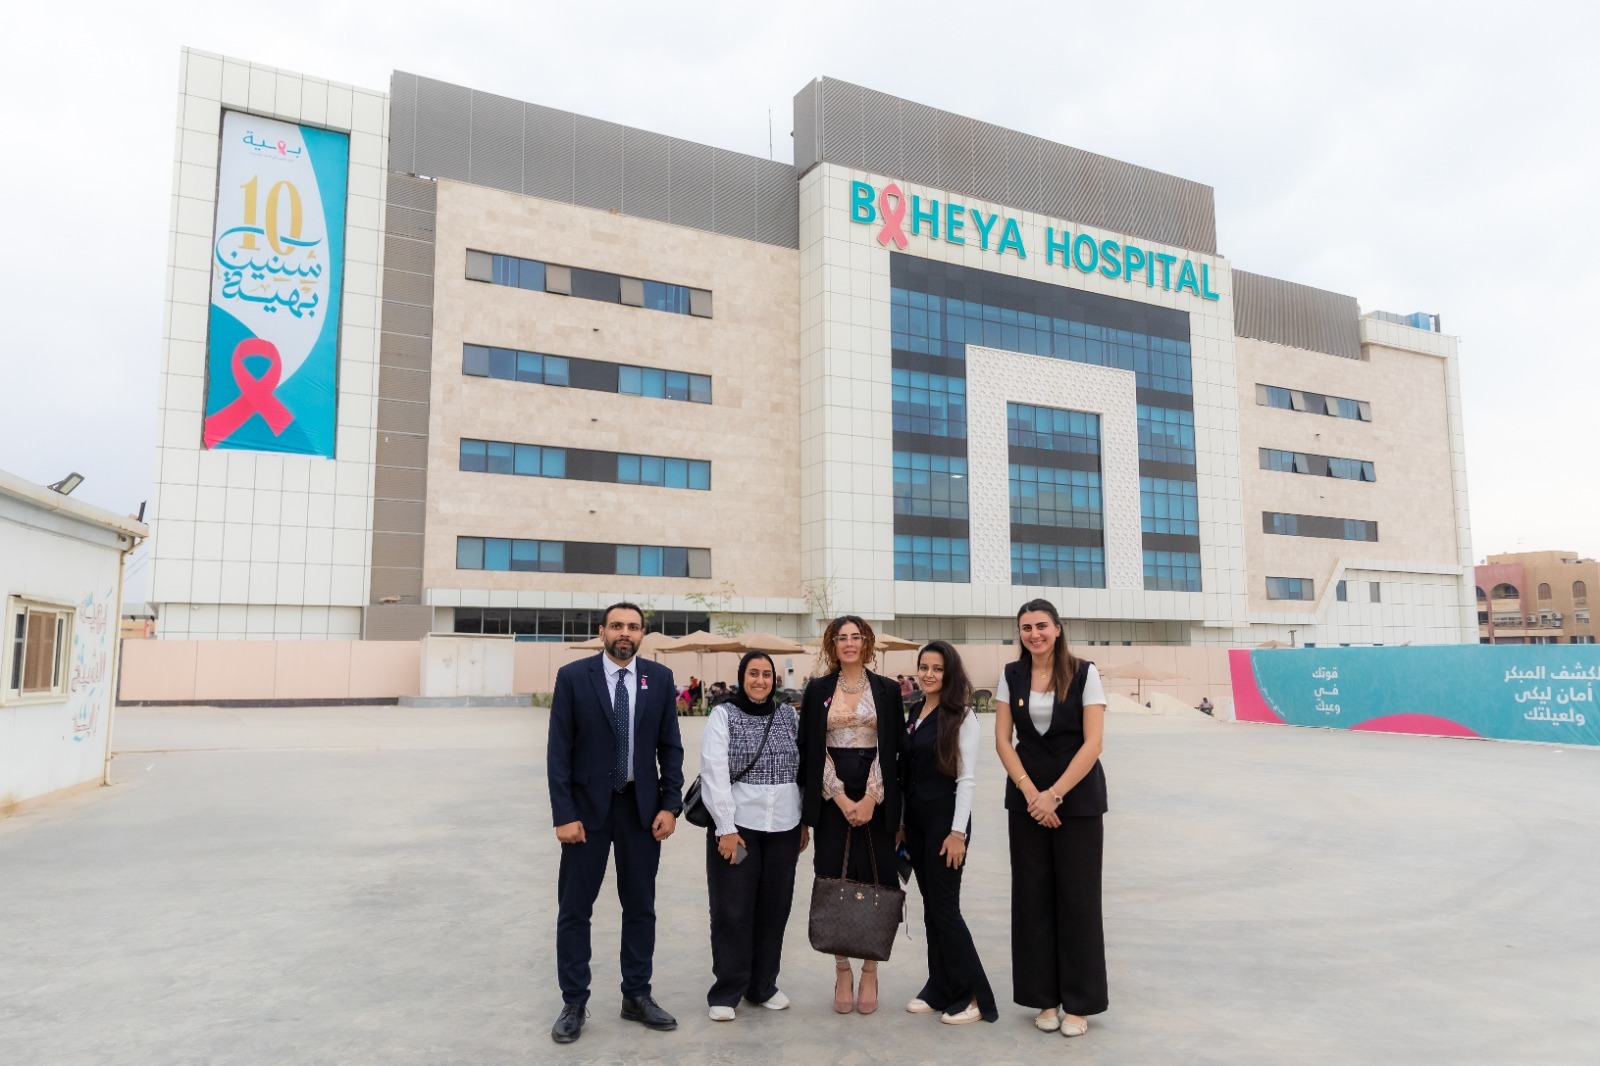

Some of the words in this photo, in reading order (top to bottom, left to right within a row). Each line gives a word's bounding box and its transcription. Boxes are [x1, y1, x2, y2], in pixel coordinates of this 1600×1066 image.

[238, 174, 302, 256] 10
[1045, 226, 1220, 301] HOSPITAL
[222, 270, 319, 319] بهية
[1312, 667, 1338, 681] قوتك
[1504, 665, 1546, 684] المبكر
[1556, 682, 1592, 704] أمان
[1315, 700, 1340, 715] وعيك
[1523, 707, 1586, 726] ولعيلتك
